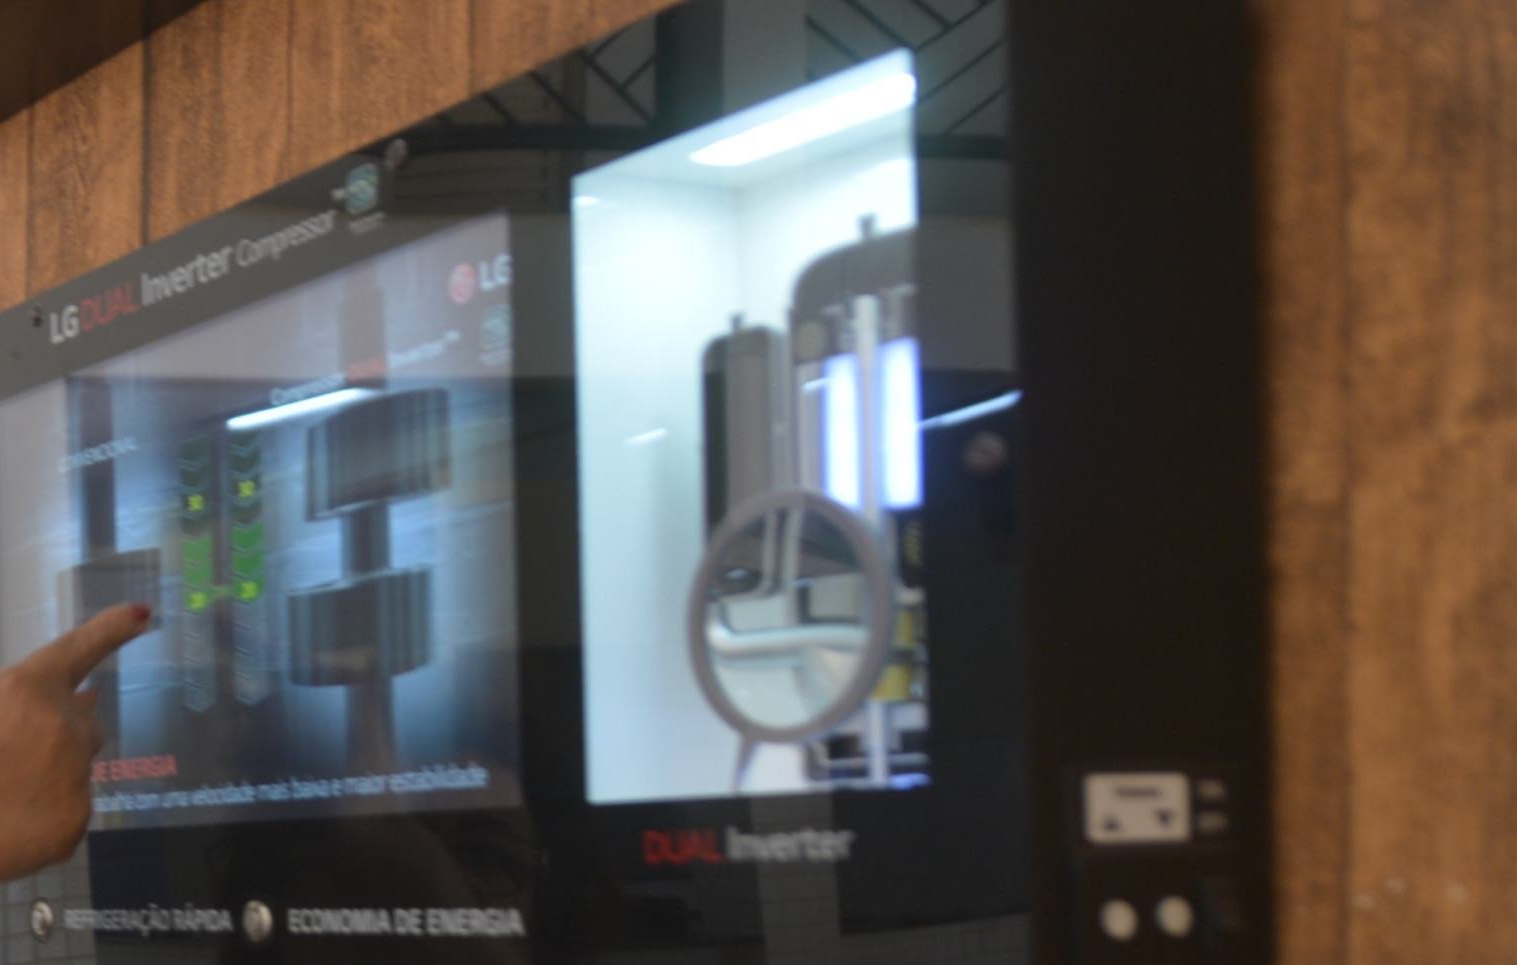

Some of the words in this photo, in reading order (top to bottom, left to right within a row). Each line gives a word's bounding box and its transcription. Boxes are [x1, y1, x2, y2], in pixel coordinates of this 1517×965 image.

[49, 303, 79, 344] LG
[79, 284, 139, 332] DUAL
[140, 246, 234, 306] Inverter
[235, 209, 337, 268] Compressor
[479, 252, 511, 292] LG
[643, 827, 724, 864] DUAL
[724, 825, 857, 863] Inverter
[287, 907, 392, 935] ECONOMIA
[392, 907, 424, 936] DE
[425, 907, 526, 938] ENERGIA
